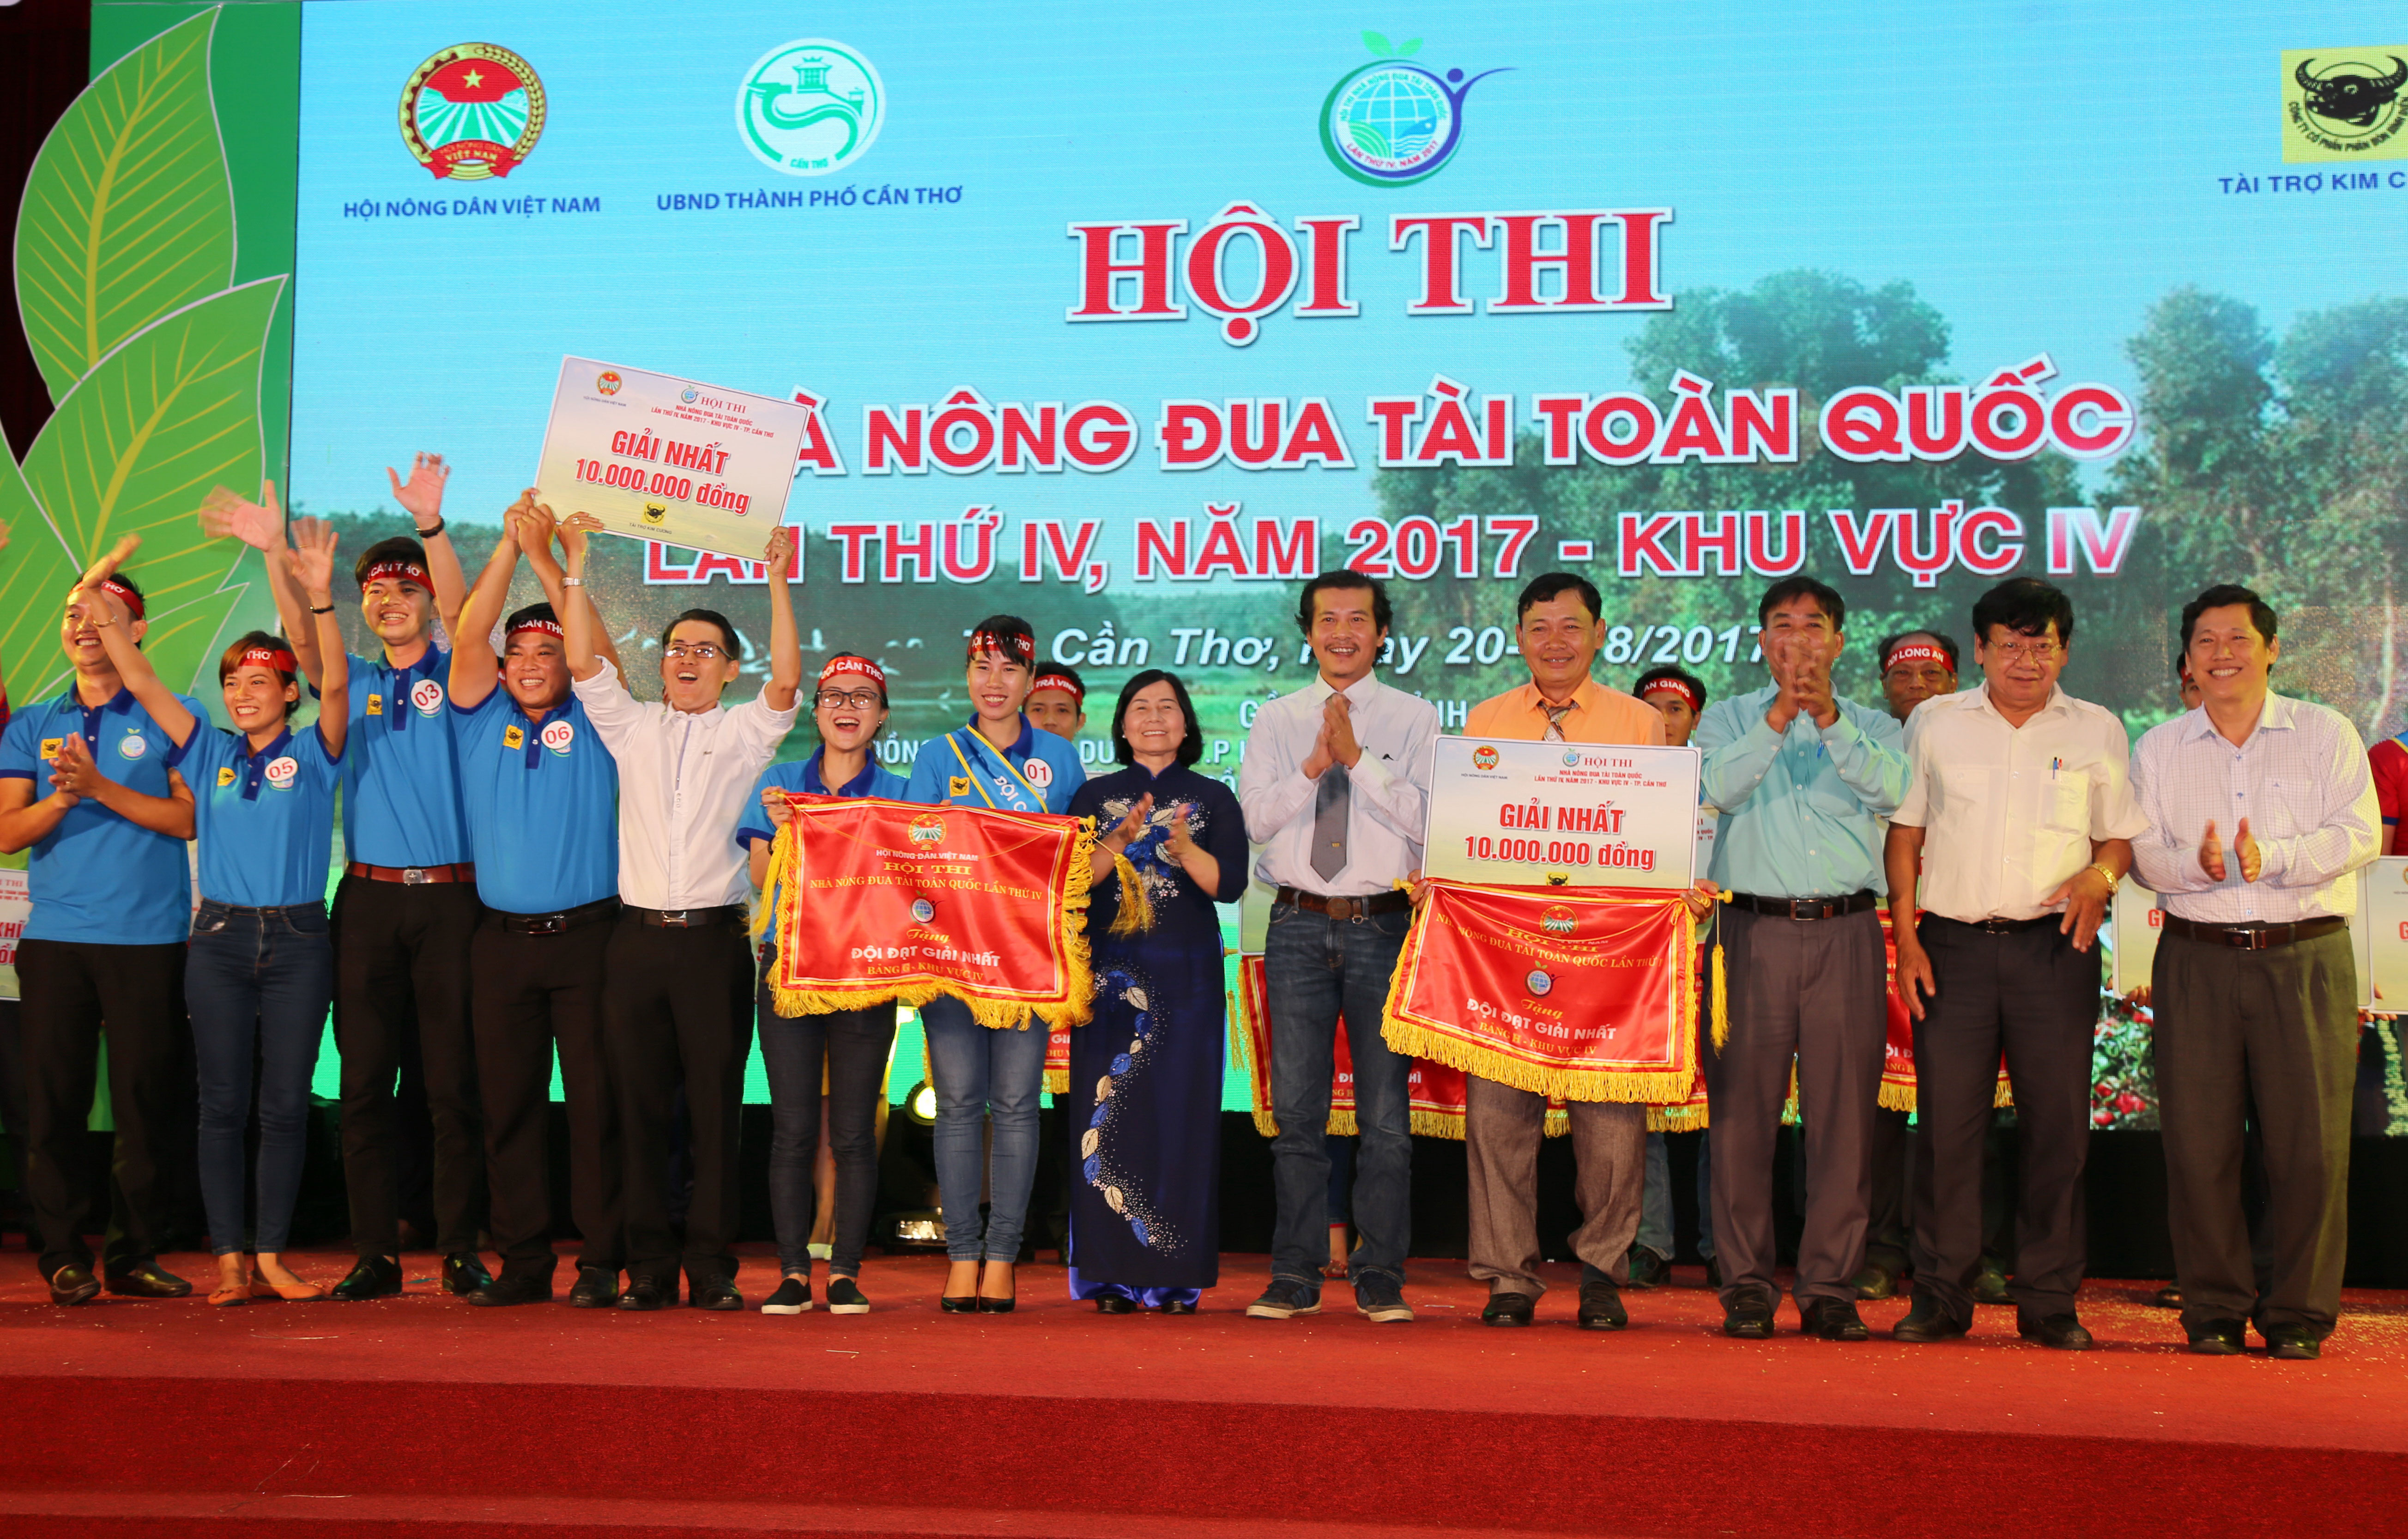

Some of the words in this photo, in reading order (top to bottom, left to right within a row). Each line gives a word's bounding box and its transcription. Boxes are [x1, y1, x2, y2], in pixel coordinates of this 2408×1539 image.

[2219, 173, 2259, 194] TÀI
[2268, 172, 2323, 194] TRỢ
[2332, 173, 2378, 191] KIM
[344, 199, 379, 221] HỘI
[387, 198, 447, 217] NÔNG
[454, 196, 496, 215] DÂN
[502, 195, 546, 218] VIỆT
[553, 197, 600, 213] NAM
[657, 194, 720, 210] UBND
[725, 188, 803, 209] THÀNH
[810, 184, 857, 207] PHỐ
[863, 184, 908, 205] CẦN
[914, 185, 962, 204] THƠ
[1066, 200, 1360, 347] HỘI
[1389, 207, 1673, 315] THI
[676, 404, 686, 412] NHÀ
[688, 407, 702, 415] NÔNG
[724, 415, 738, 423] TOÀN
[738, 418, 753, 426] QUỐC
[680, 412, 693, 420] NĂM
[700, 396, 723, 410] HỘI
[726, 401, 747, 414] THI
[862, 385, 1137, 476] NÔNG
[1155, 396, 1357, 471] ĐUA
[1367, 371, 1514, 468] TÀI
[1532, 368, 1797, 466] TOÀN
[1820, 352, 2137, 462] QUỐC
[611, 428, 661, 461] GIẢI
[664, 441, 731, 478] NHẤT
[575, 458, 692, 501] 10.000.000
[696, 482, 751, 516] đồng
[827, 504, 1003, 584] THỨ
[1019, 518, 1104, 594] IV,
[1134, 502, 1320, 583] NĂM
[1343, 514, 1539, 581] 2017
[1618, 509, 1806, 576] KHU
[1827, 498, 2026, 588] VỰC
[2046, 506, 2141, 576] IV
[247, 650, 272, 660] THƠ
[1052, 620, 1149, 666] Cần
[1169, 628, 1281, 672] Thơ,
[1899, 648, 1930, 659] LONG
[1932, 650, 1944, 663] AN
[415, 684, 439, 706] 03
[1057, 679, 1077, 694] VINH
[1644, 681, 1657, 692] AN
[1660, 680, 1690, 698] GIANG
[545, 726, 569, 744] 06
[269, 761, 293, 778] 05
[1027, 763, 1047, 782] 01
[1584, 756, 1607, 769] HỘI
[1610, 758, 1633, 768] THI
[993, 776, 1019, 802] ĐỘI
[1499, 796, 1551, 830] GIẢI
[1557, 800, 1625, 835] NHẤT
[876, 849, 891, 858] HỘI
[893, 850, 915, 860] NÔNG
[917, 852, 937, 860] DÂN
[938, 851, 958, 861] VIỆT
[1464, 835, 1591, 867] 10.000.000
[1597, 840, 1655, 872] đồng
[883, 861, 924, 874] HỘI
[931, 865, 972, 875] THI
[810, 877, 833, 889] NHÀ
[835, 876, 865, 888] NÔNG
[868, 876, 893, 885] ĐUA
[895, 874, 913, 886] TÀI
[915, 877, 946, 888] TOÀN
[949, 878, 981, 891] QUỐC
[984, 880, 1007, 895] LẦN
[1008, 887, 1030, 899] THỨ
[1032, 891, 1042, 900] IV
[906, 928, 951, 944] Tặng
[1435, 913, 1454, 928] NH
[1458, 927, 1488, 943] NÔNG
[1490, 937, 1513, 951] ĐUA
[1515, 942, 1535, 957] TÀI
[1537, 948, 1571, 963] TOÀN
[1572, 954, 1608, 967] QUỐC
[1610, 954, 1634, 968] LẦN
[1636, 955, 1658, 967] THỨ
[1506, 927, 1549, 946] HỘI
[851, 945, 883, 963] ĐỘI
[887, 945, 918, 961] ĐẠT
[922, 945, 957, 961] GIẢI
[962, 951, 1001, 967] NHẤT
[867, 963, 900, 975] BẢNG
[918, 962, 944, 974] KHU
[946, 967, 971, 978] VỰC
[973, 972, 984, 981] IV
[1466, 998, 1497, 1019] ĐỘI
[1501, 1010, 1531, 1030] ĐẠT
[1535, 1021, 1569, 1039] GIẢI
[1574, 1023, 1617, 1039] NHẤT
[1521, 998, 1564, 1020] Tặng
[1478, 1021, 1511, 1039] BẢNG
[1512, 1033, 1522, 1044] H
[1529, 1038, 1555, 1053] KHU
[1557, 1045, 1582, 1057] VỰC
[1584, 1045, 1598, 1055] IV
[1885, 1042, 1899, 1059] ỘI
[1408, 1071, 1422, 1084] HÌ
